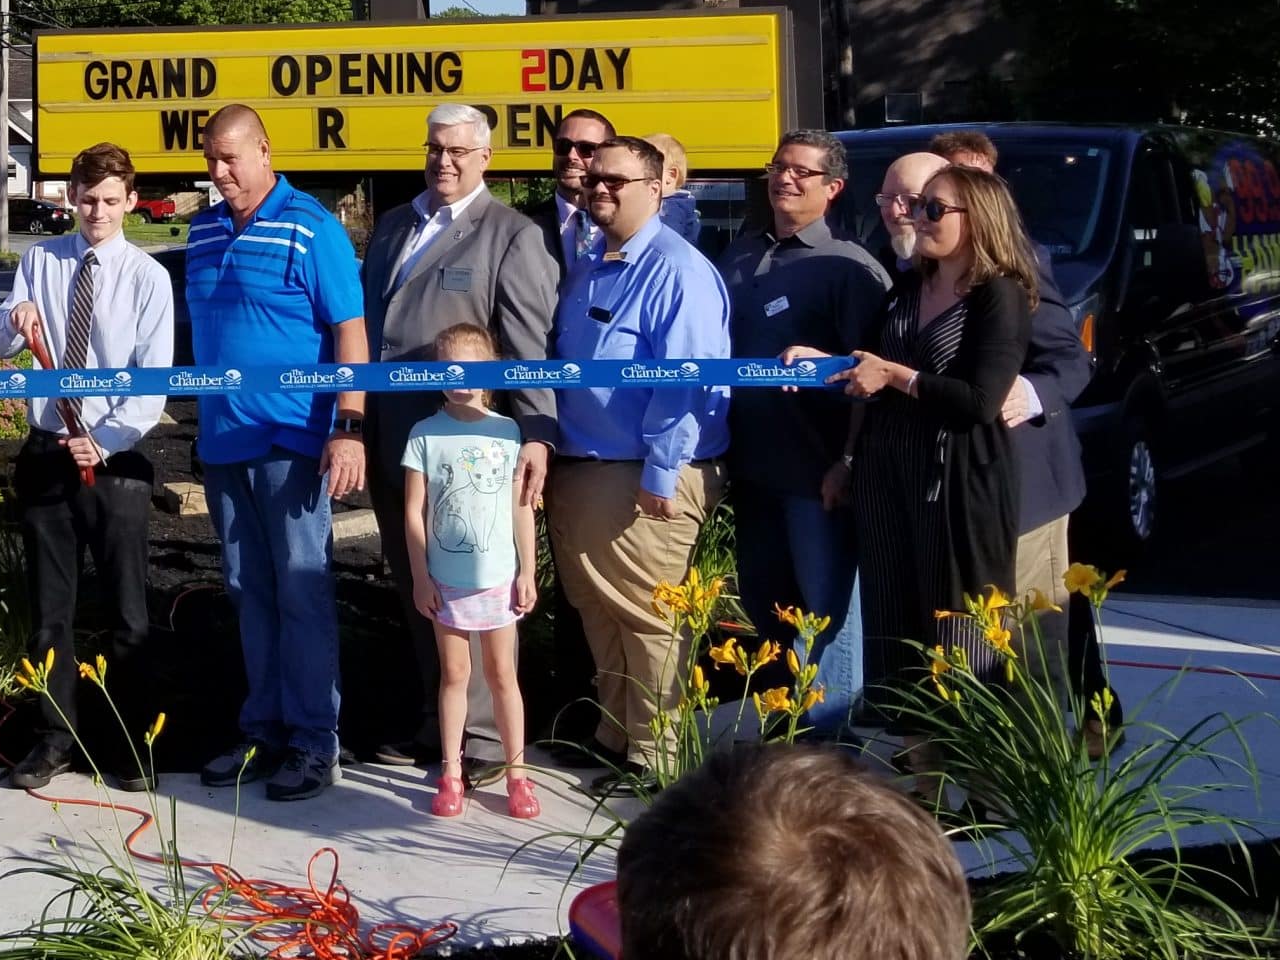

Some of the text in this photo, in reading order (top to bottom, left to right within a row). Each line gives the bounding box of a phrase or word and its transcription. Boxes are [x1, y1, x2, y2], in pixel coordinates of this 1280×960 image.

[84, 48, 631, 100] GRAND OPENING 2DAY
[317, 106, 347, 149] R
[504, 366, 561, 380] Chamber
[516, 364, 528, 372] The
[621, 365, 680, 378] Chamber
[737, 364, 797, 377] Chamber
[60, 375, 113, 388] Chamber
[169, 373, 223, 386] Chamber
[280, 371, 334, 384] Chamber
[389, 369, 445, 382] Chamber
